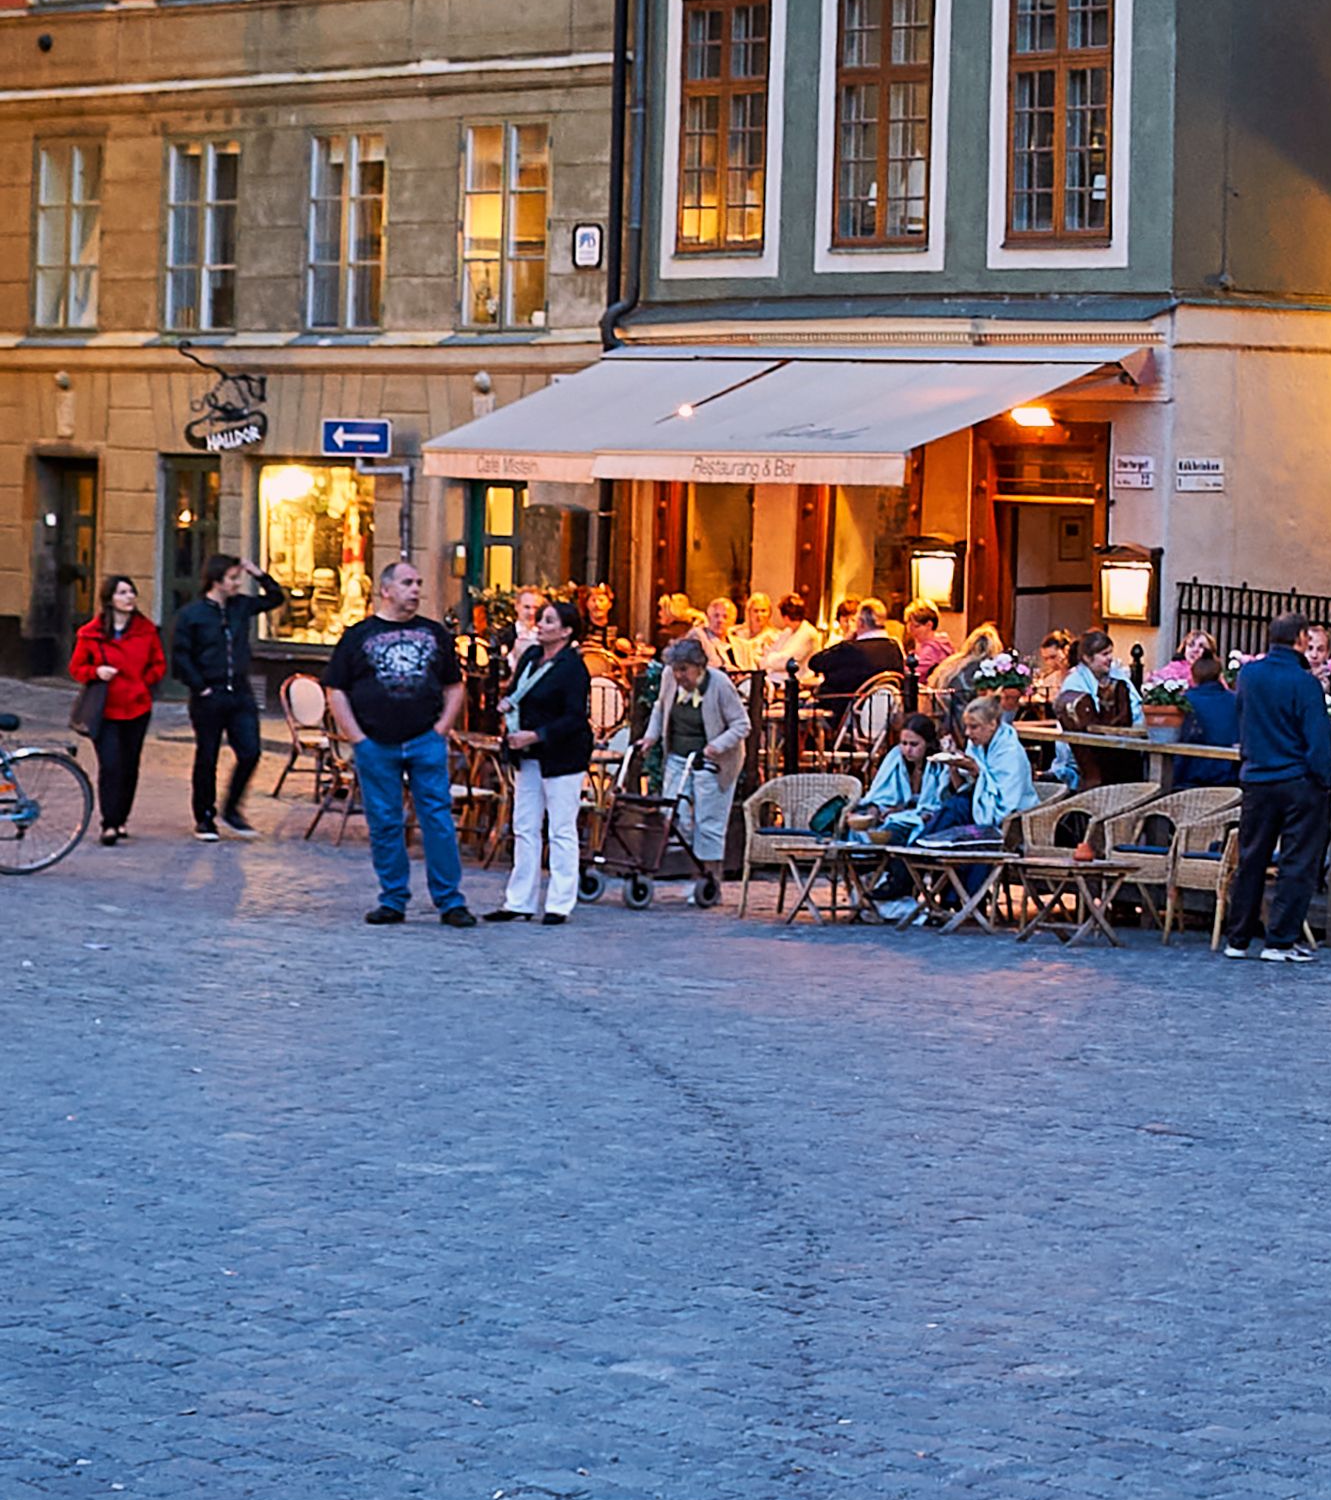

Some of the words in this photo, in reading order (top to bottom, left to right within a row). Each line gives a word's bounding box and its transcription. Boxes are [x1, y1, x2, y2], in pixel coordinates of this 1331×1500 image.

[692, 456, 759, 480] Restaurang
[762, 459, 771, 477] &
[774, 459, 795, 477] Bar
